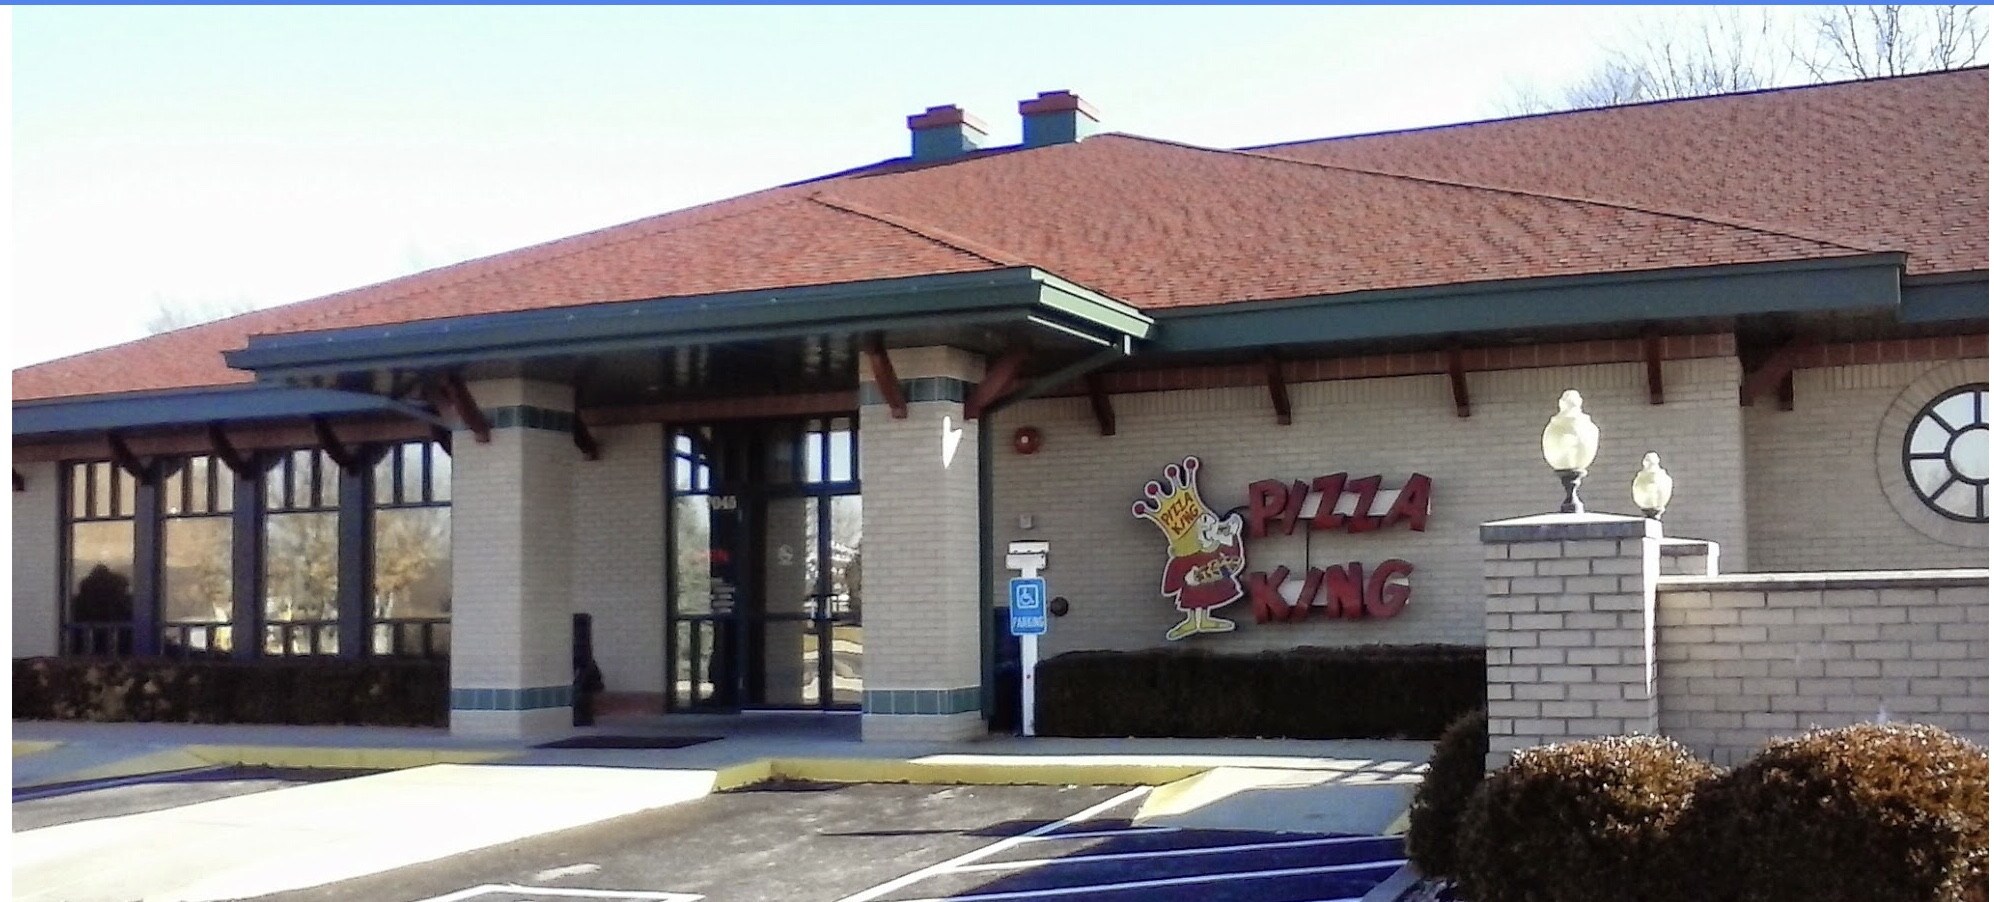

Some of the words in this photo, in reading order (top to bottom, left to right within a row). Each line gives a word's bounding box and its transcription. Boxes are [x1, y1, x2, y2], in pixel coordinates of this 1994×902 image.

[1161, 492, 1194, 526] PIZZA
[1171, 503, 1199, 535] KING
[1249, 472, 1431, 537] PIZZA
[1250, 558, 1413, 624] KING
